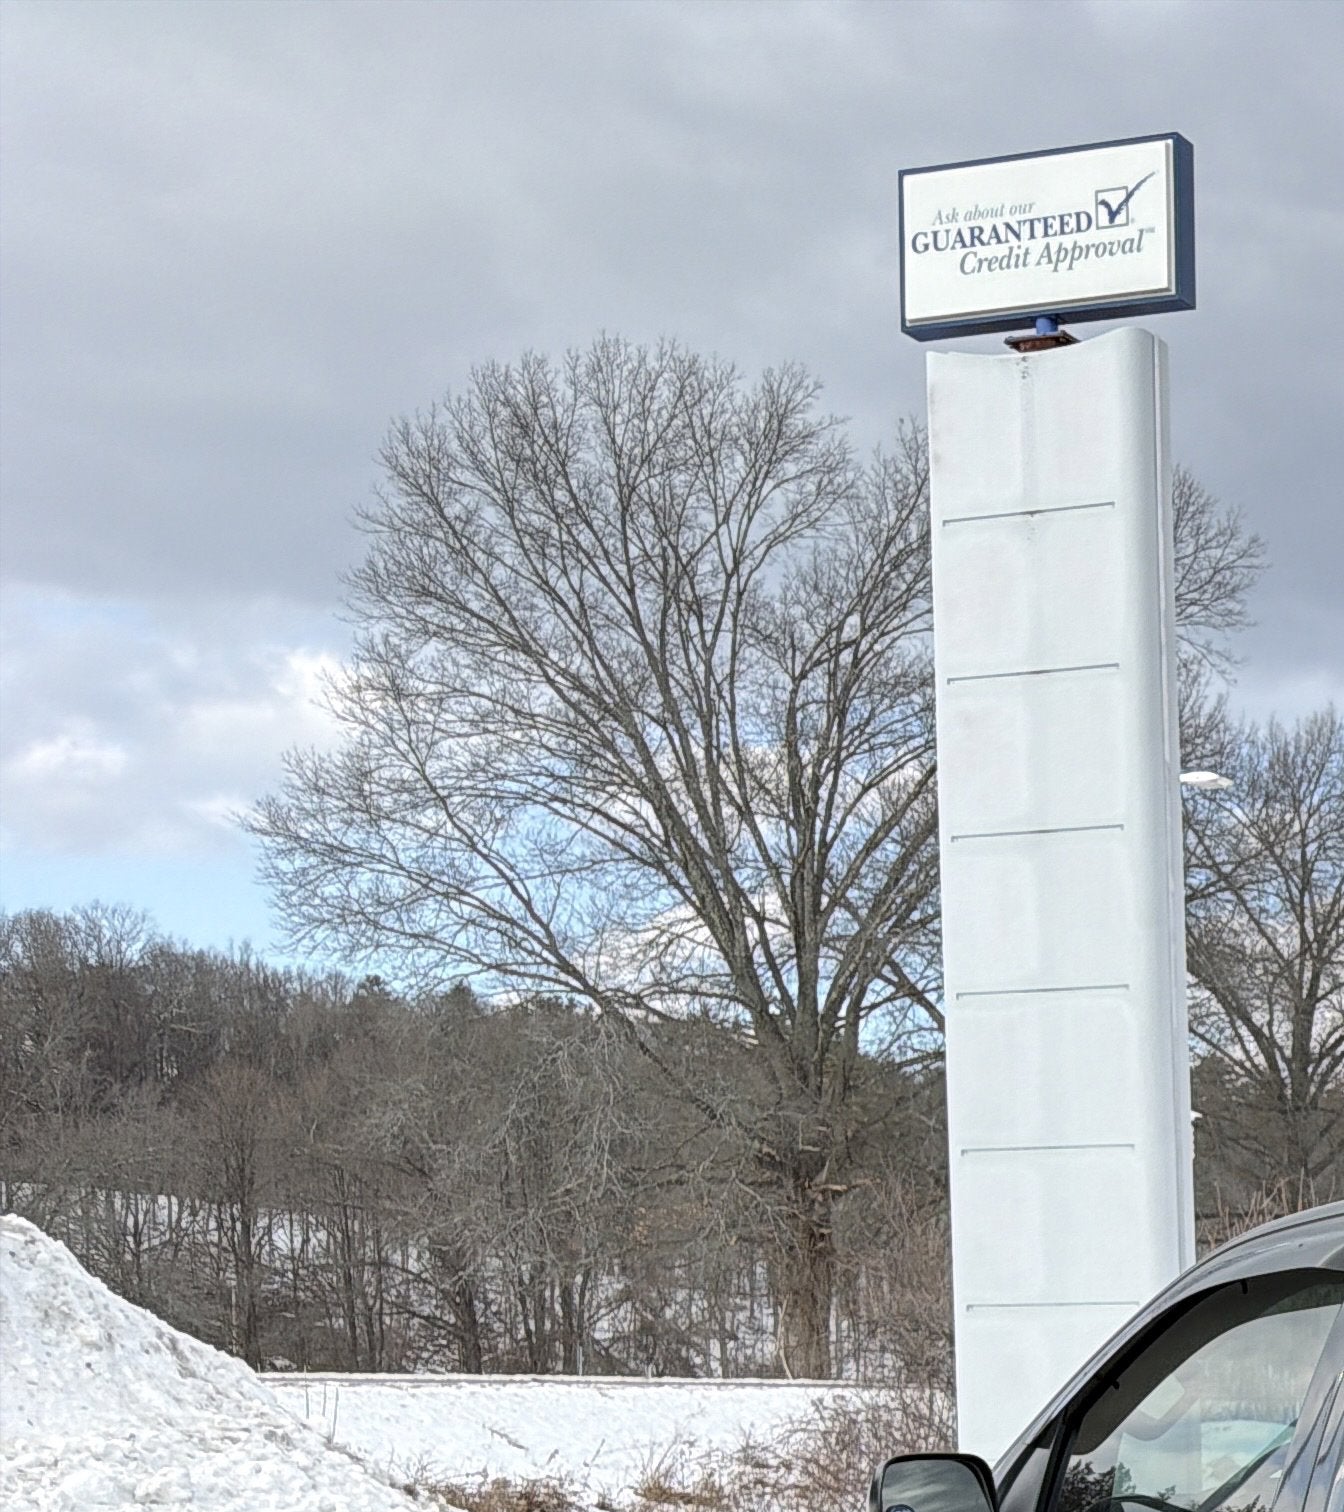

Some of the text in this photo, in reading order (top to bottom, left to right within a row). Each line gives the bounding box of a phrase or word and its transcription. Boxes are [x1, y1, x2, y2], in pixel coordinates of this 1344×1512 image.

[911, 211, 1093, 254] GUARANTEED
[932, 200, 1035, 226] Ask about our
[960, 229, 1146, 275] Credit Approval
